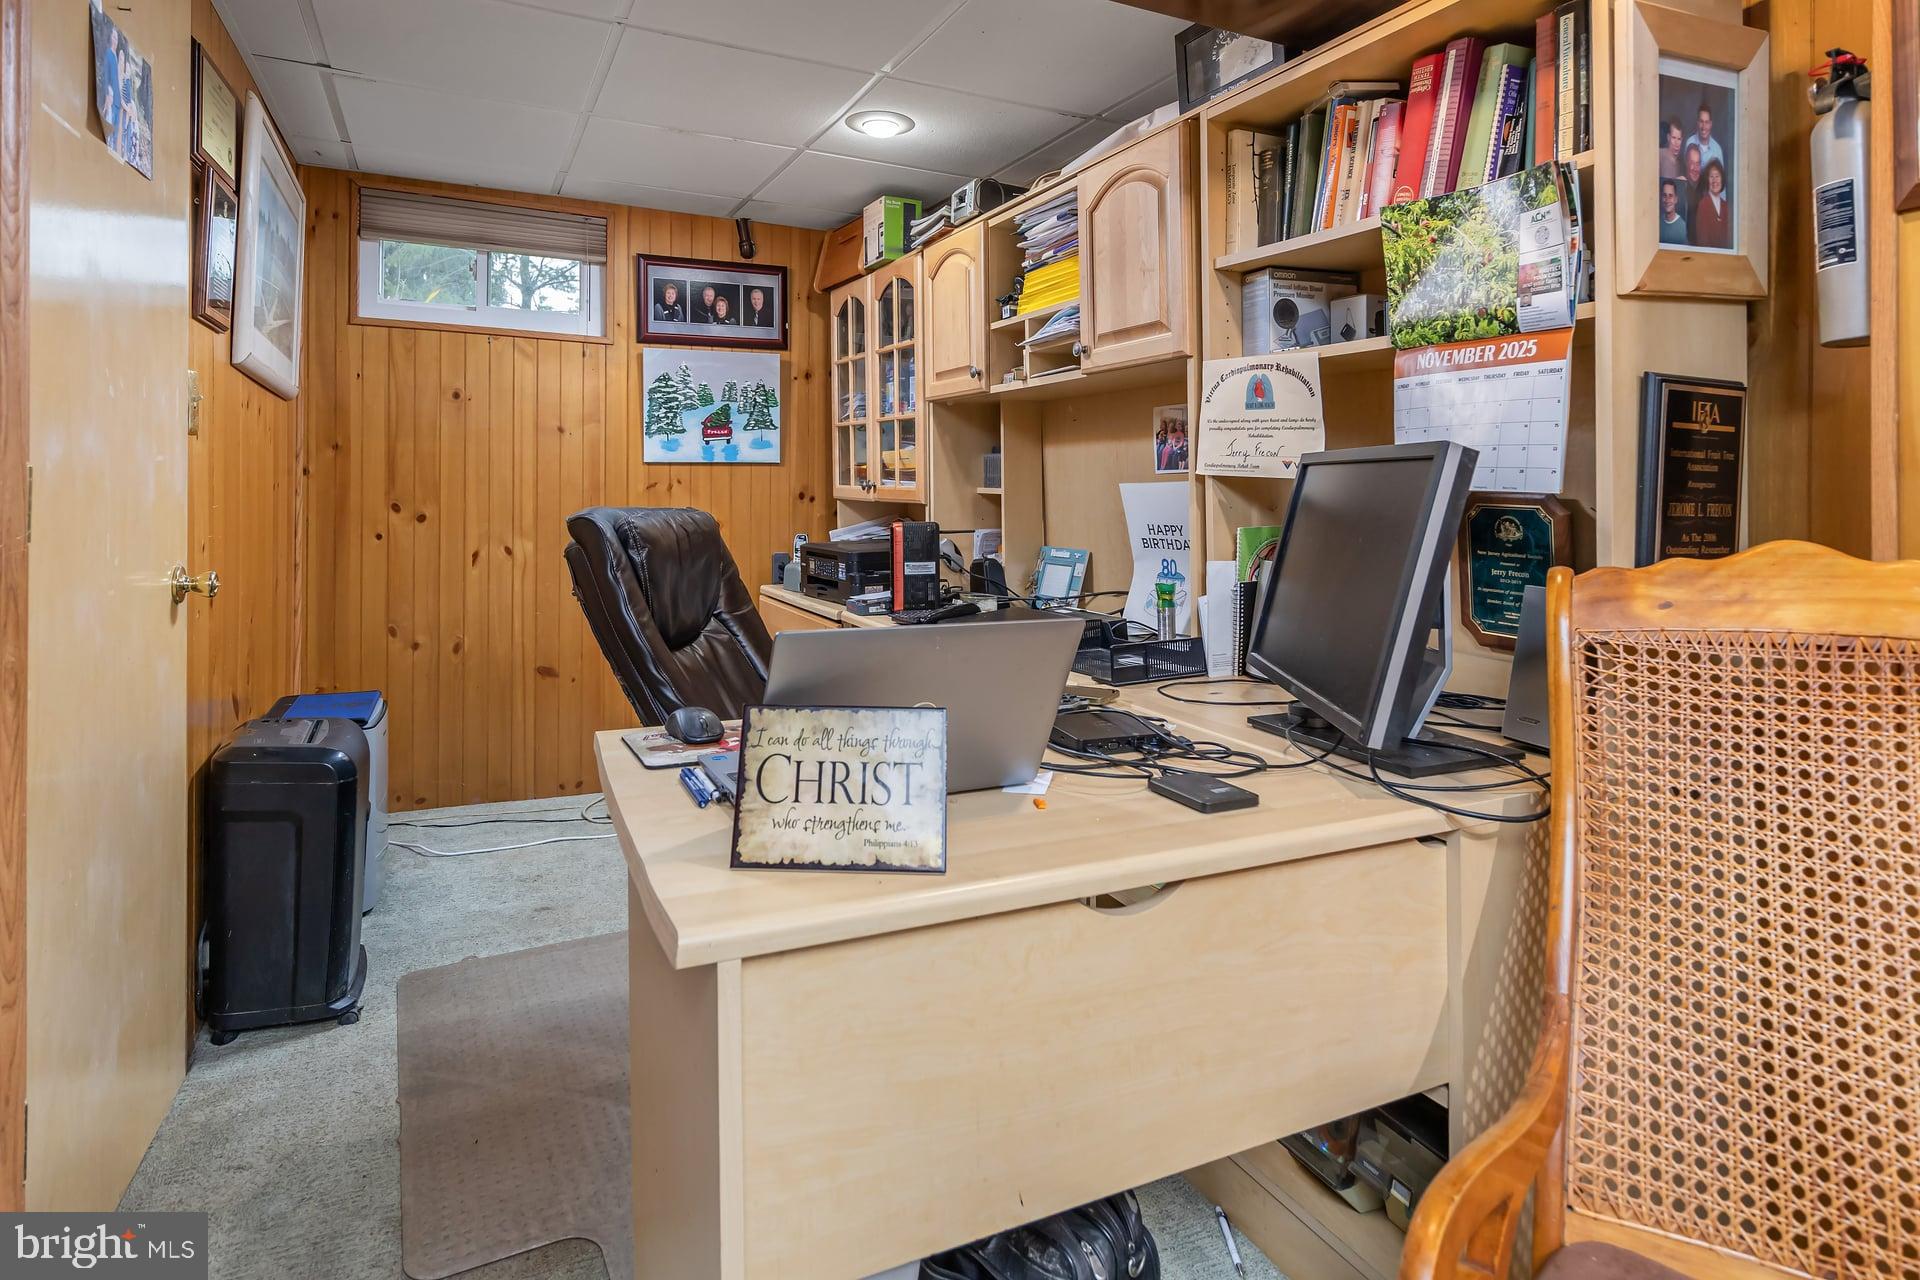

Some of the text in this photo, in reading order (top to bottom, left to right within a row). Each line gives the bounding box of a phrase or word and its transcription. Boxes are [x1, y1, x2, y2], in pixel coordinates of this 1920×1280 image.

[1296, 291, 1315, 299] Monitor
[1416, 339, 1538, 370] NOVEMBER 2025
[1538, 367, 1564, 375] SATURDAY
[1275, 362, 1316, 398] Rehabilitation
[1226, 438, 1250, 463] Jerry
[1667, 502, 1695, 517] JEROME
[1147, 523, 1184, 537] HAPPY
[1141, 537, 1190, 551] BIRTHDA
[1161, 558, 1178, 577] 80
[1491, 568, 1506, 577] Jerry
[751, 726, 944, 758] I can do all things through
[755, 753, 924, 806] CHRIST
[772, 806, 906, 840] who strengthens me.
[863, 838, 899, 850] Philippians
